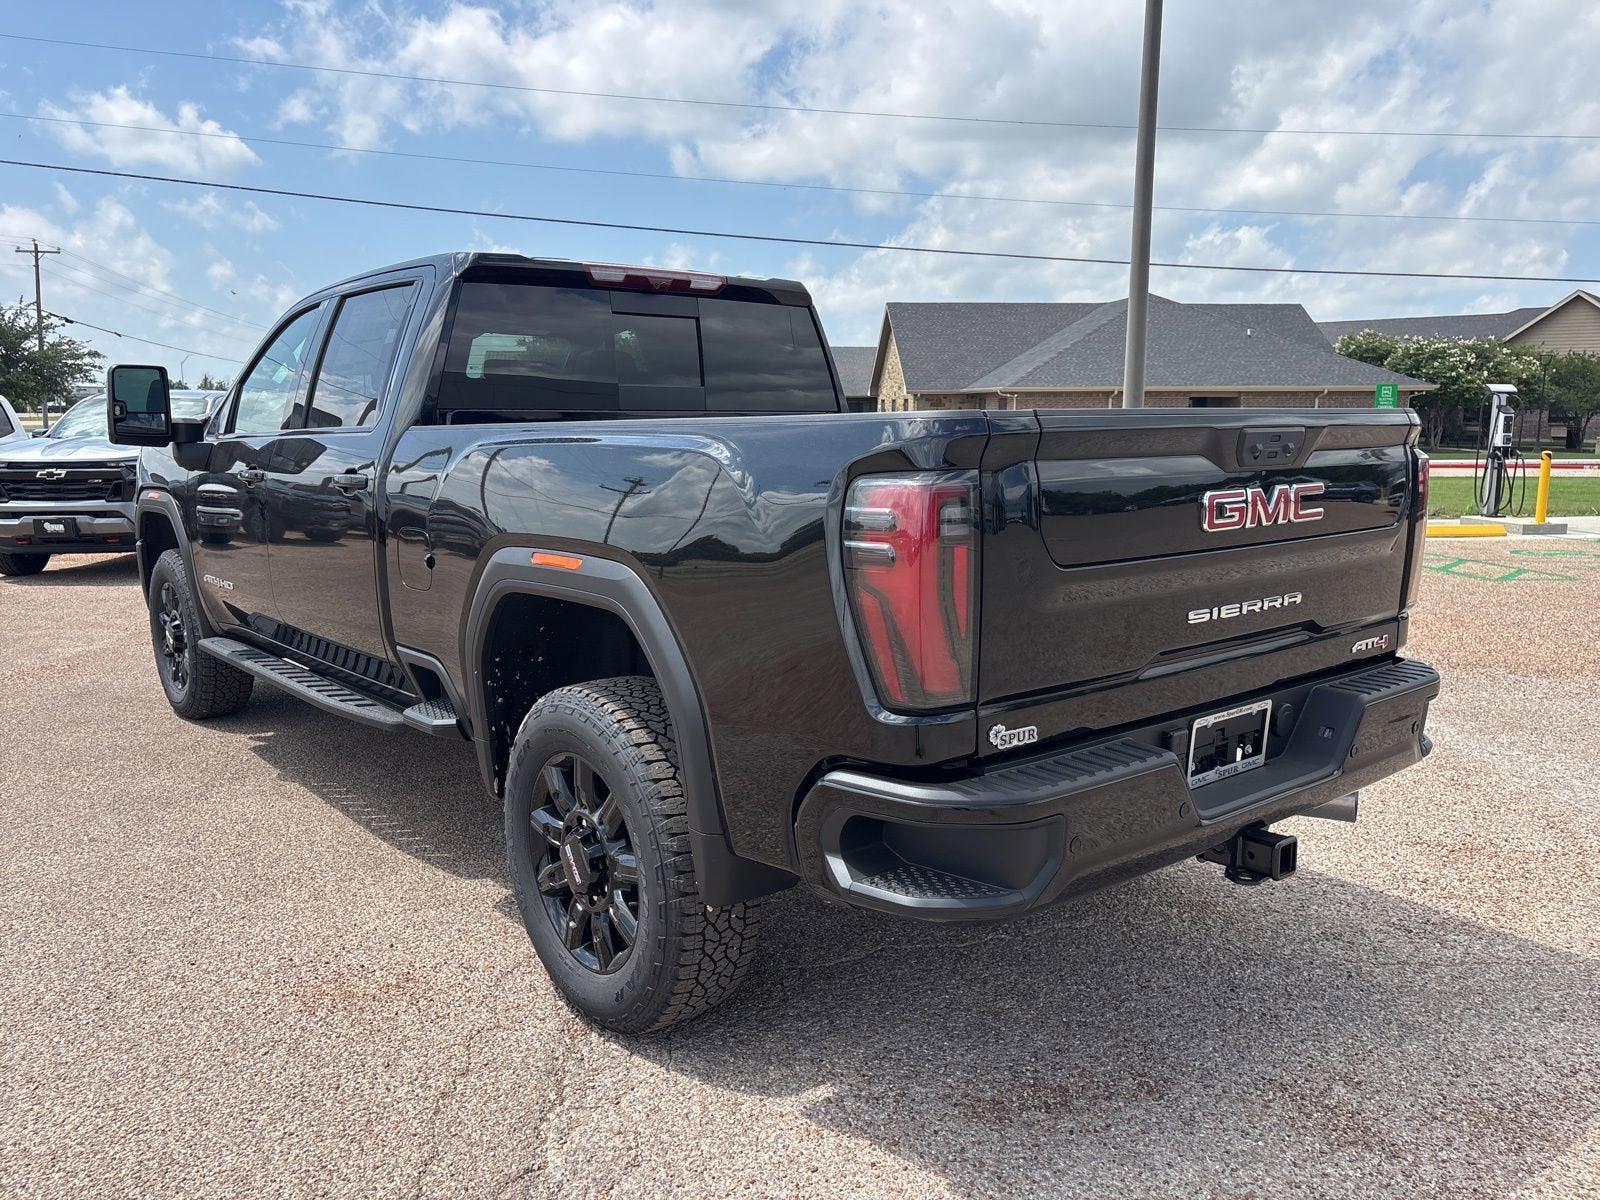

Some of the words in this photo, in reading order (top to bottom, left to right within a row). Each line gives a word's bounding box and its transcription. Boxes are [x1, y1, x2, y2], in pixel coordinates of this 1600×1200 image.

[1202, 482, 1325, 532] GMC
[1187, 591, 1302, 624] SIERRA
[1351, 634, 1389, 654] AT4
[1000, 728, 1035, 746] SPUR
[1191, 774, 1210, 786] GMC
[1217, 764, 1239, 778] SPUR
[1241, 758, 1260, 769] GMC
